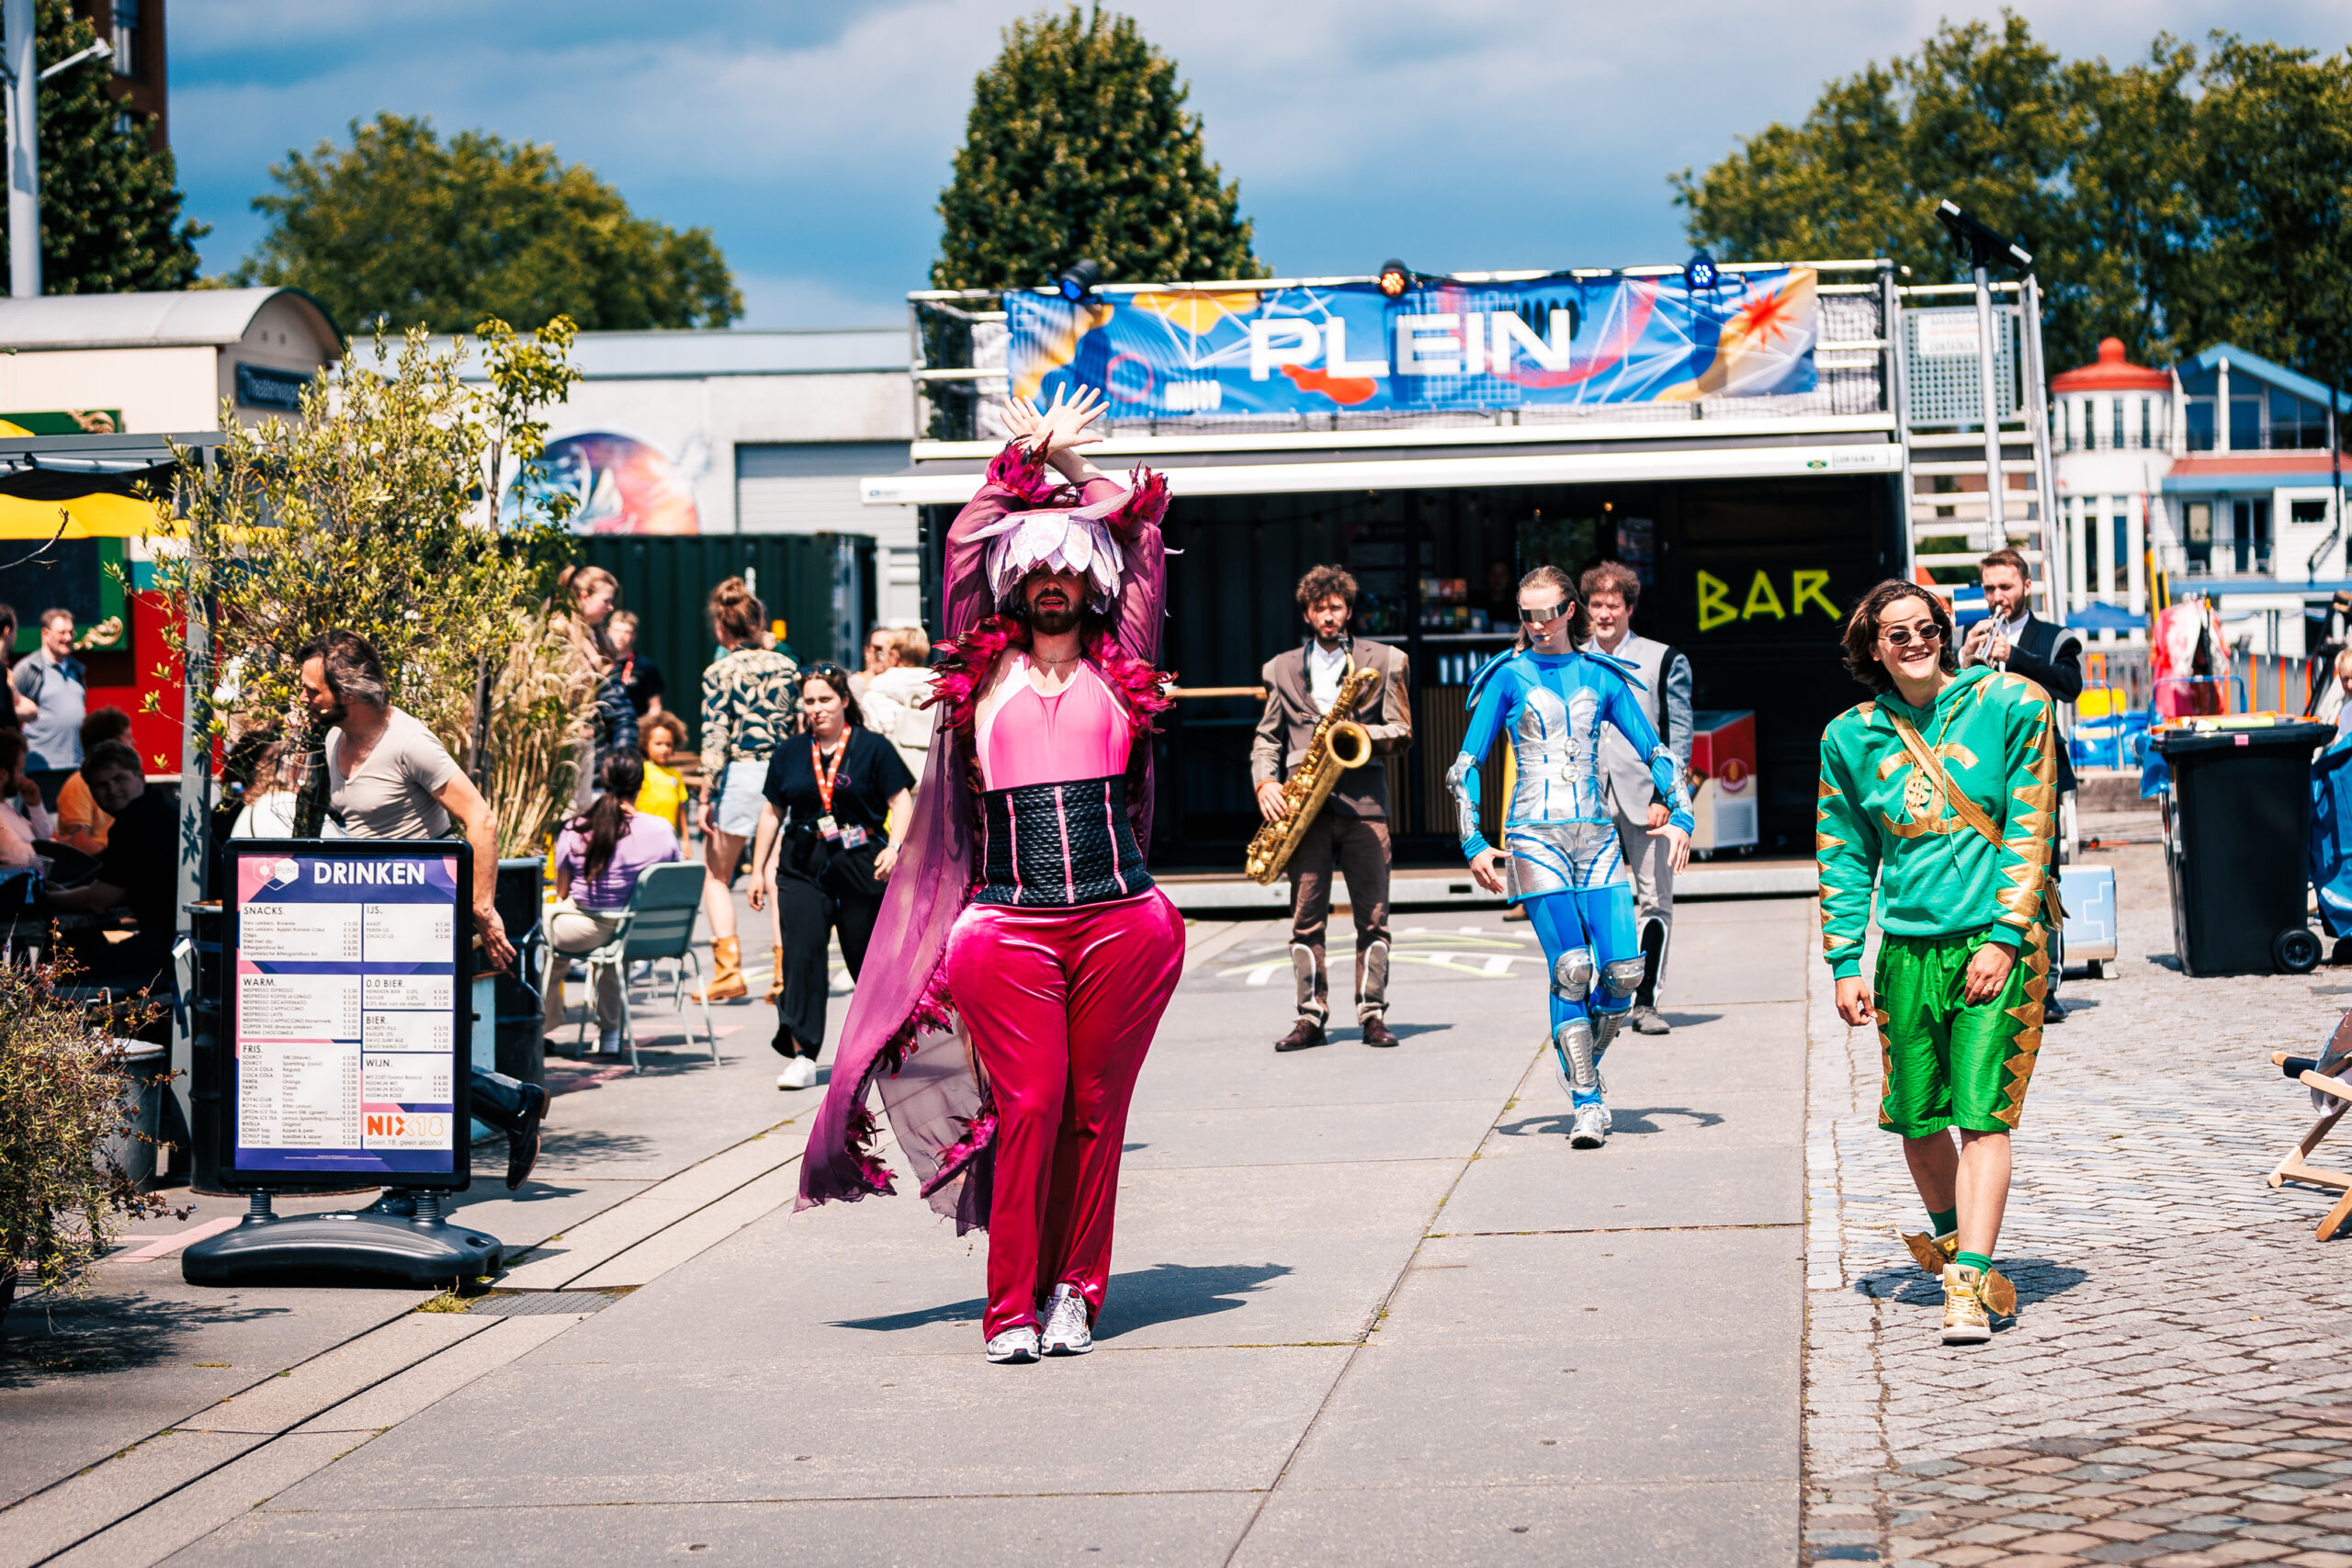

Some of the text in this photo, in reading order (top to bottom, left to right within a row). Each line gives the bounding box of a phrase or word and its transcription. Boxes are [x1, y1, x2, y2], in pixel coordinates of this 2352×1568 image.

[1250, 310, 1570, 381] PLEIN
[1697, 570, 1842, 631] BAR
[314, 862, 425, 885] DRINKEN
[366, 979, 380, 987] 0.0
[368, 1115, 445, 1137] NIX18
